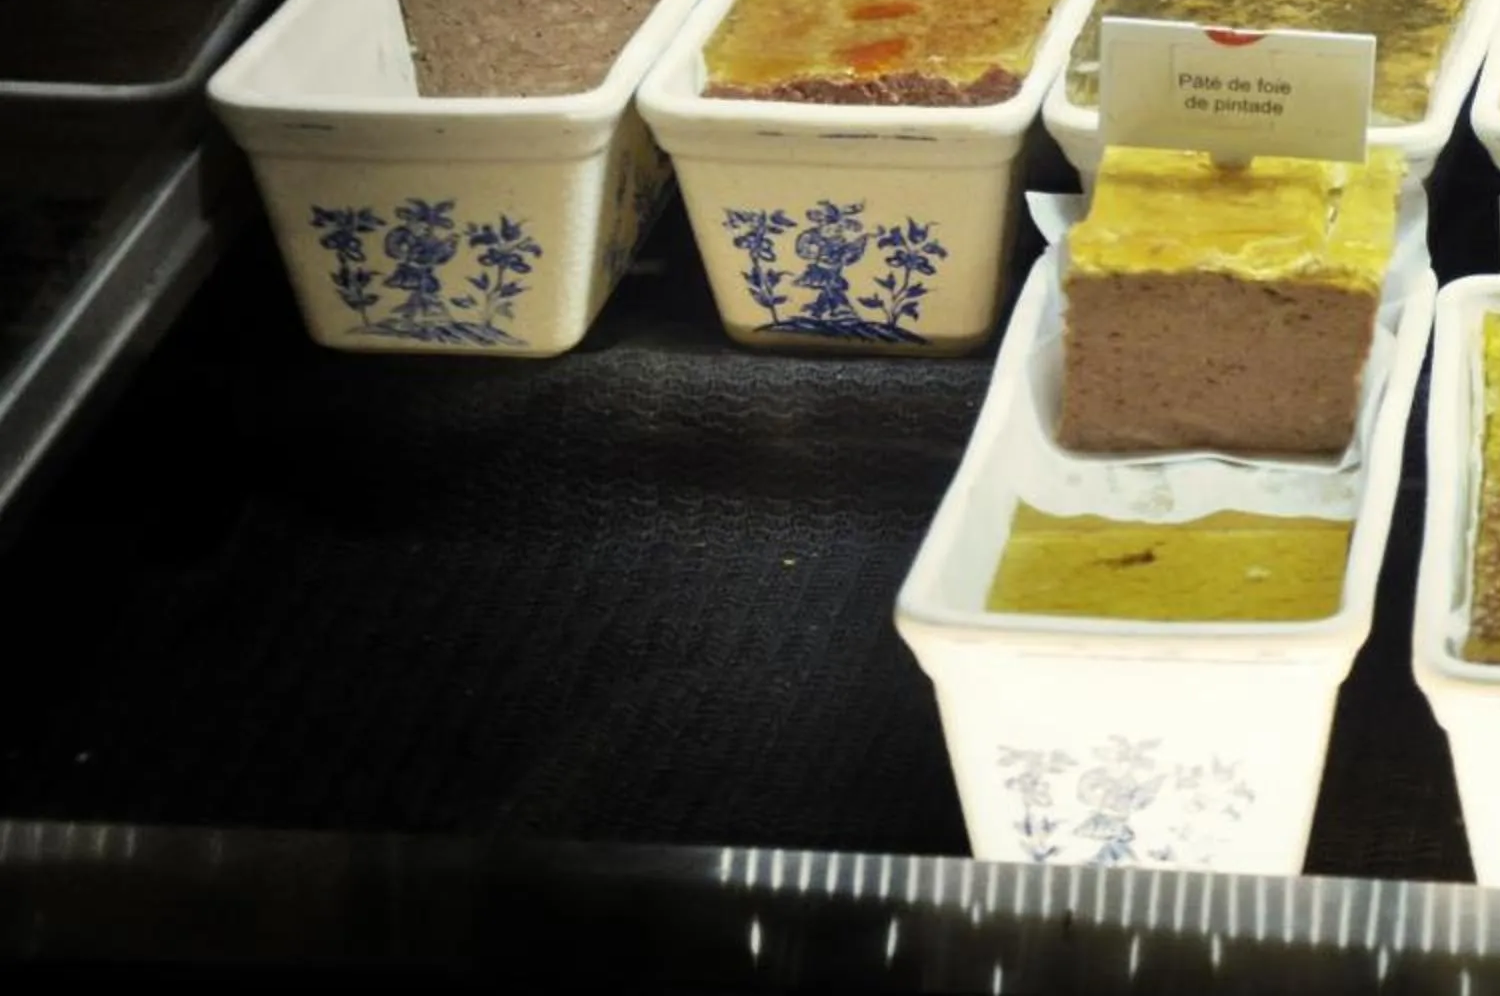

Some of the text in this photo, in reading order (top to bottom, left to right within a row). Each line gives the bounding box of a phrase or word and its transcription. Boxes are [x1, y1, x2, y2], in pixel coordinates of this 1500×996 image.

[1228, 76, 1252, 93] de
[1257, 78, 1292, 95] foie
[1185, 95, 1284, 116] de pintade
